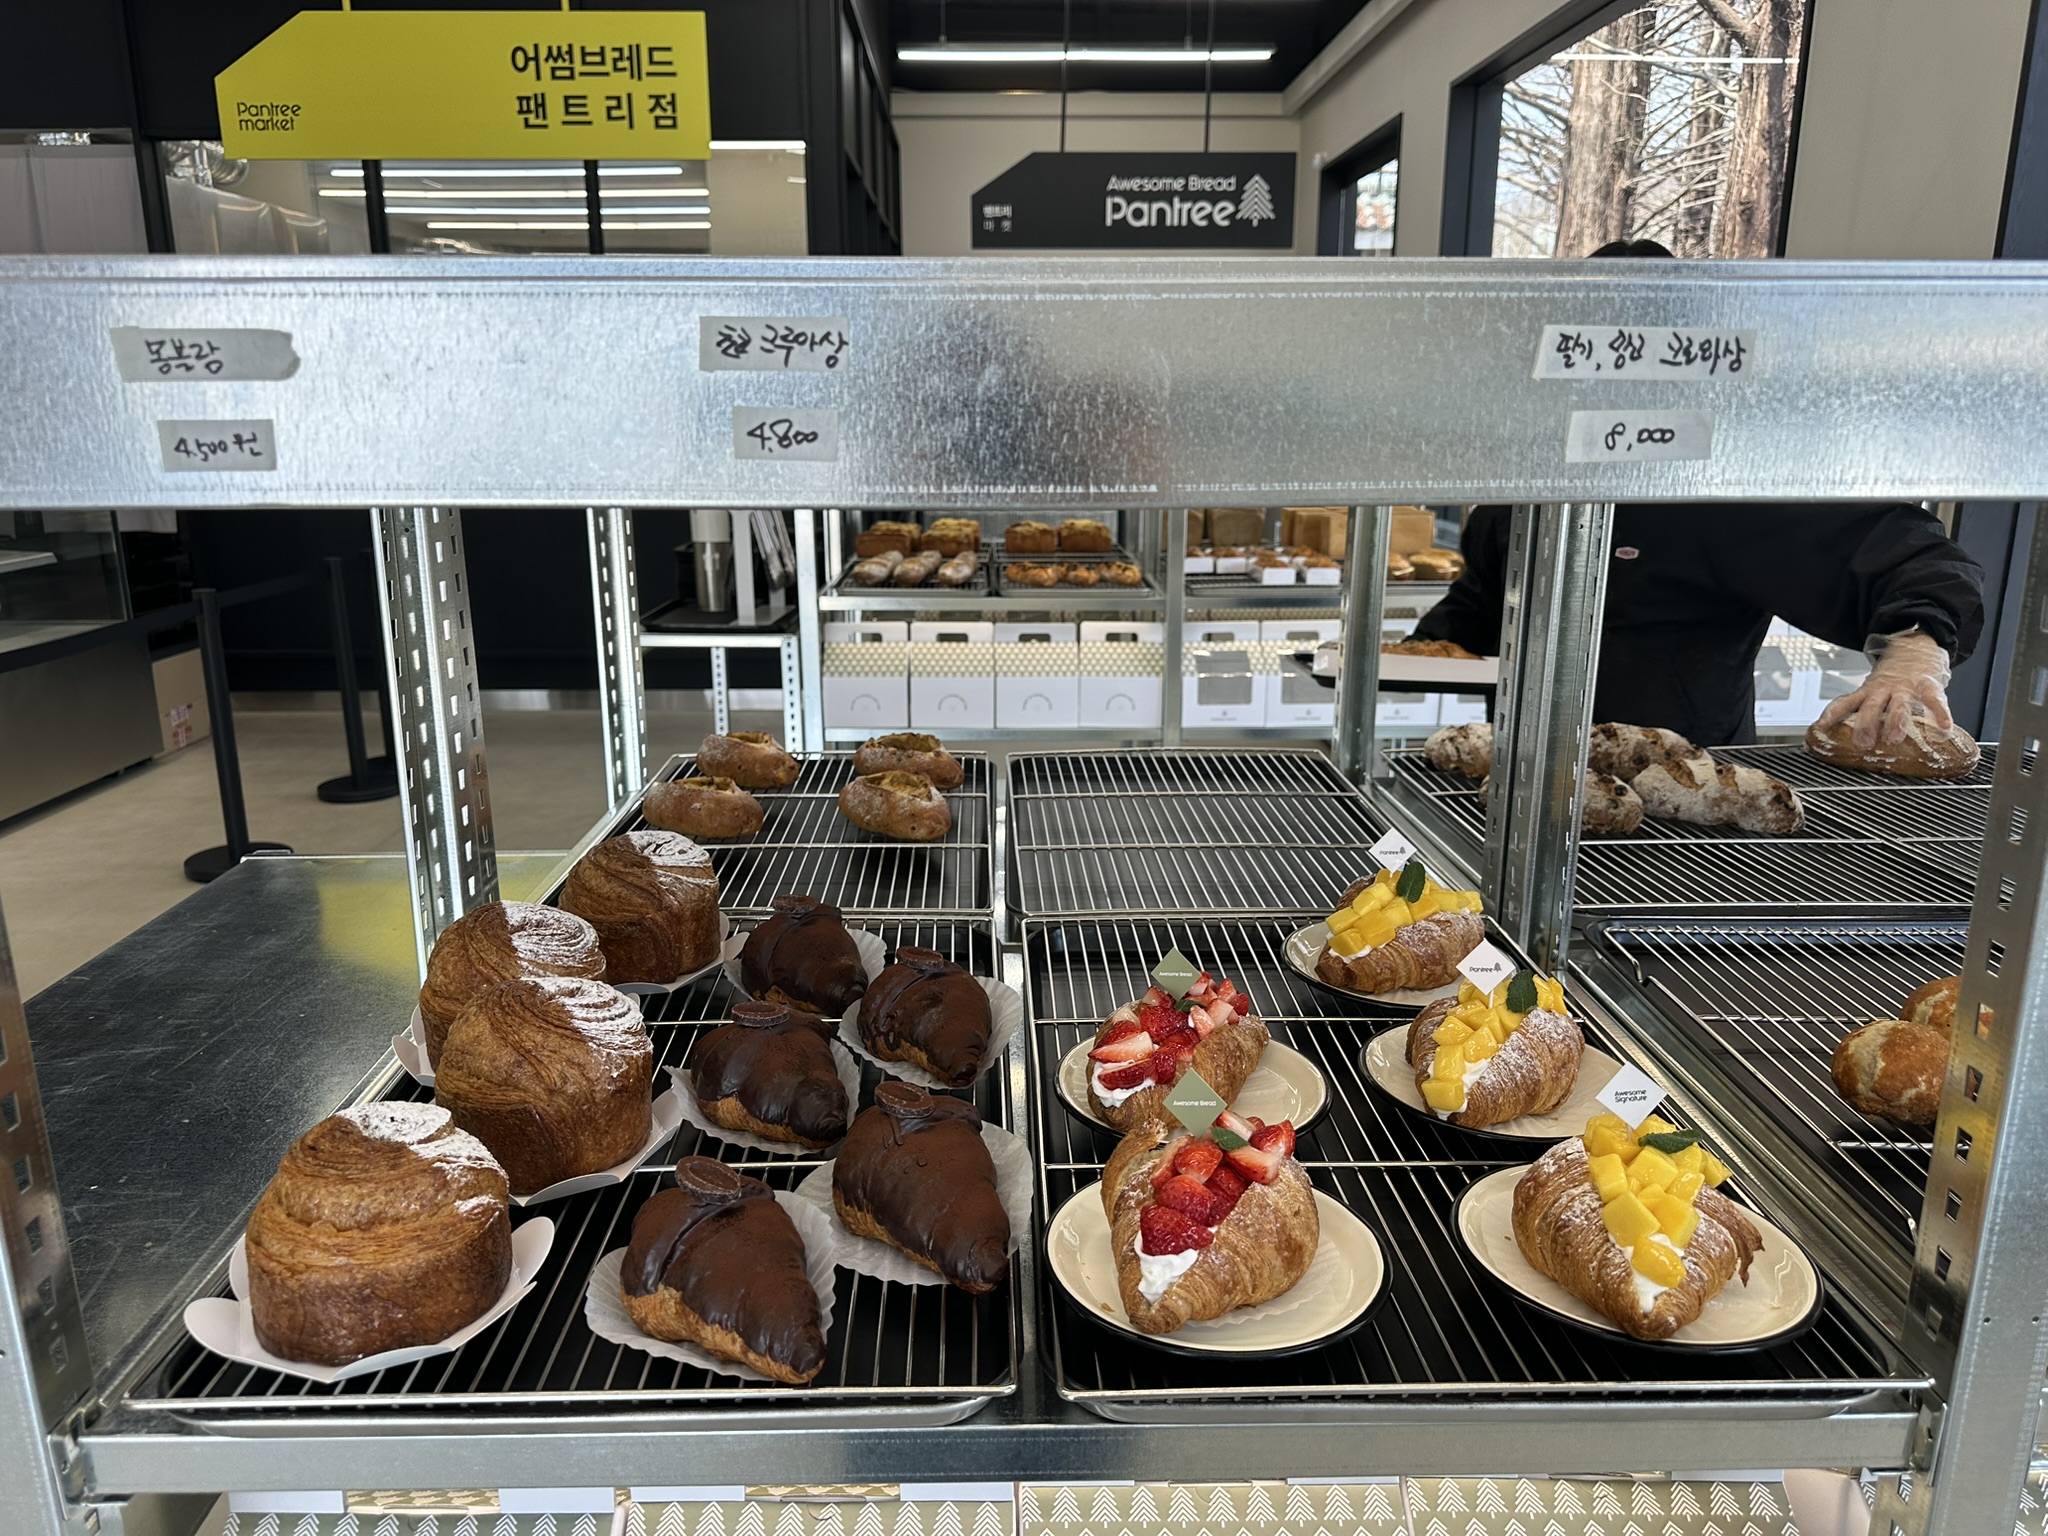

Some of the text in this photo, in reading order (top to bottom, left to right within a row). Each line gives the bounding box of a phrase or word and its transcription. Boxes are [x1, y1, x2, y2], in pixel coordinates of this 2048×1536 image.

[511, 43, 677, 81] 어썸브레드
[236, 101, 301, 119] Pantree
[516, 92, 679, 130] 팬트리점
[239, 116, 295, 131] market
[1106, 174, 1237, 192] Awesome Bread
[1104, 196, 1236, 227] Pantree
[144, 338, 224, 375] 몽블랑
[1604, 422, 1675, 452] 8,000
[1614, 1089, 1647, 1097] Awesome
[1614, 1096, 1648, 1104] Signature
